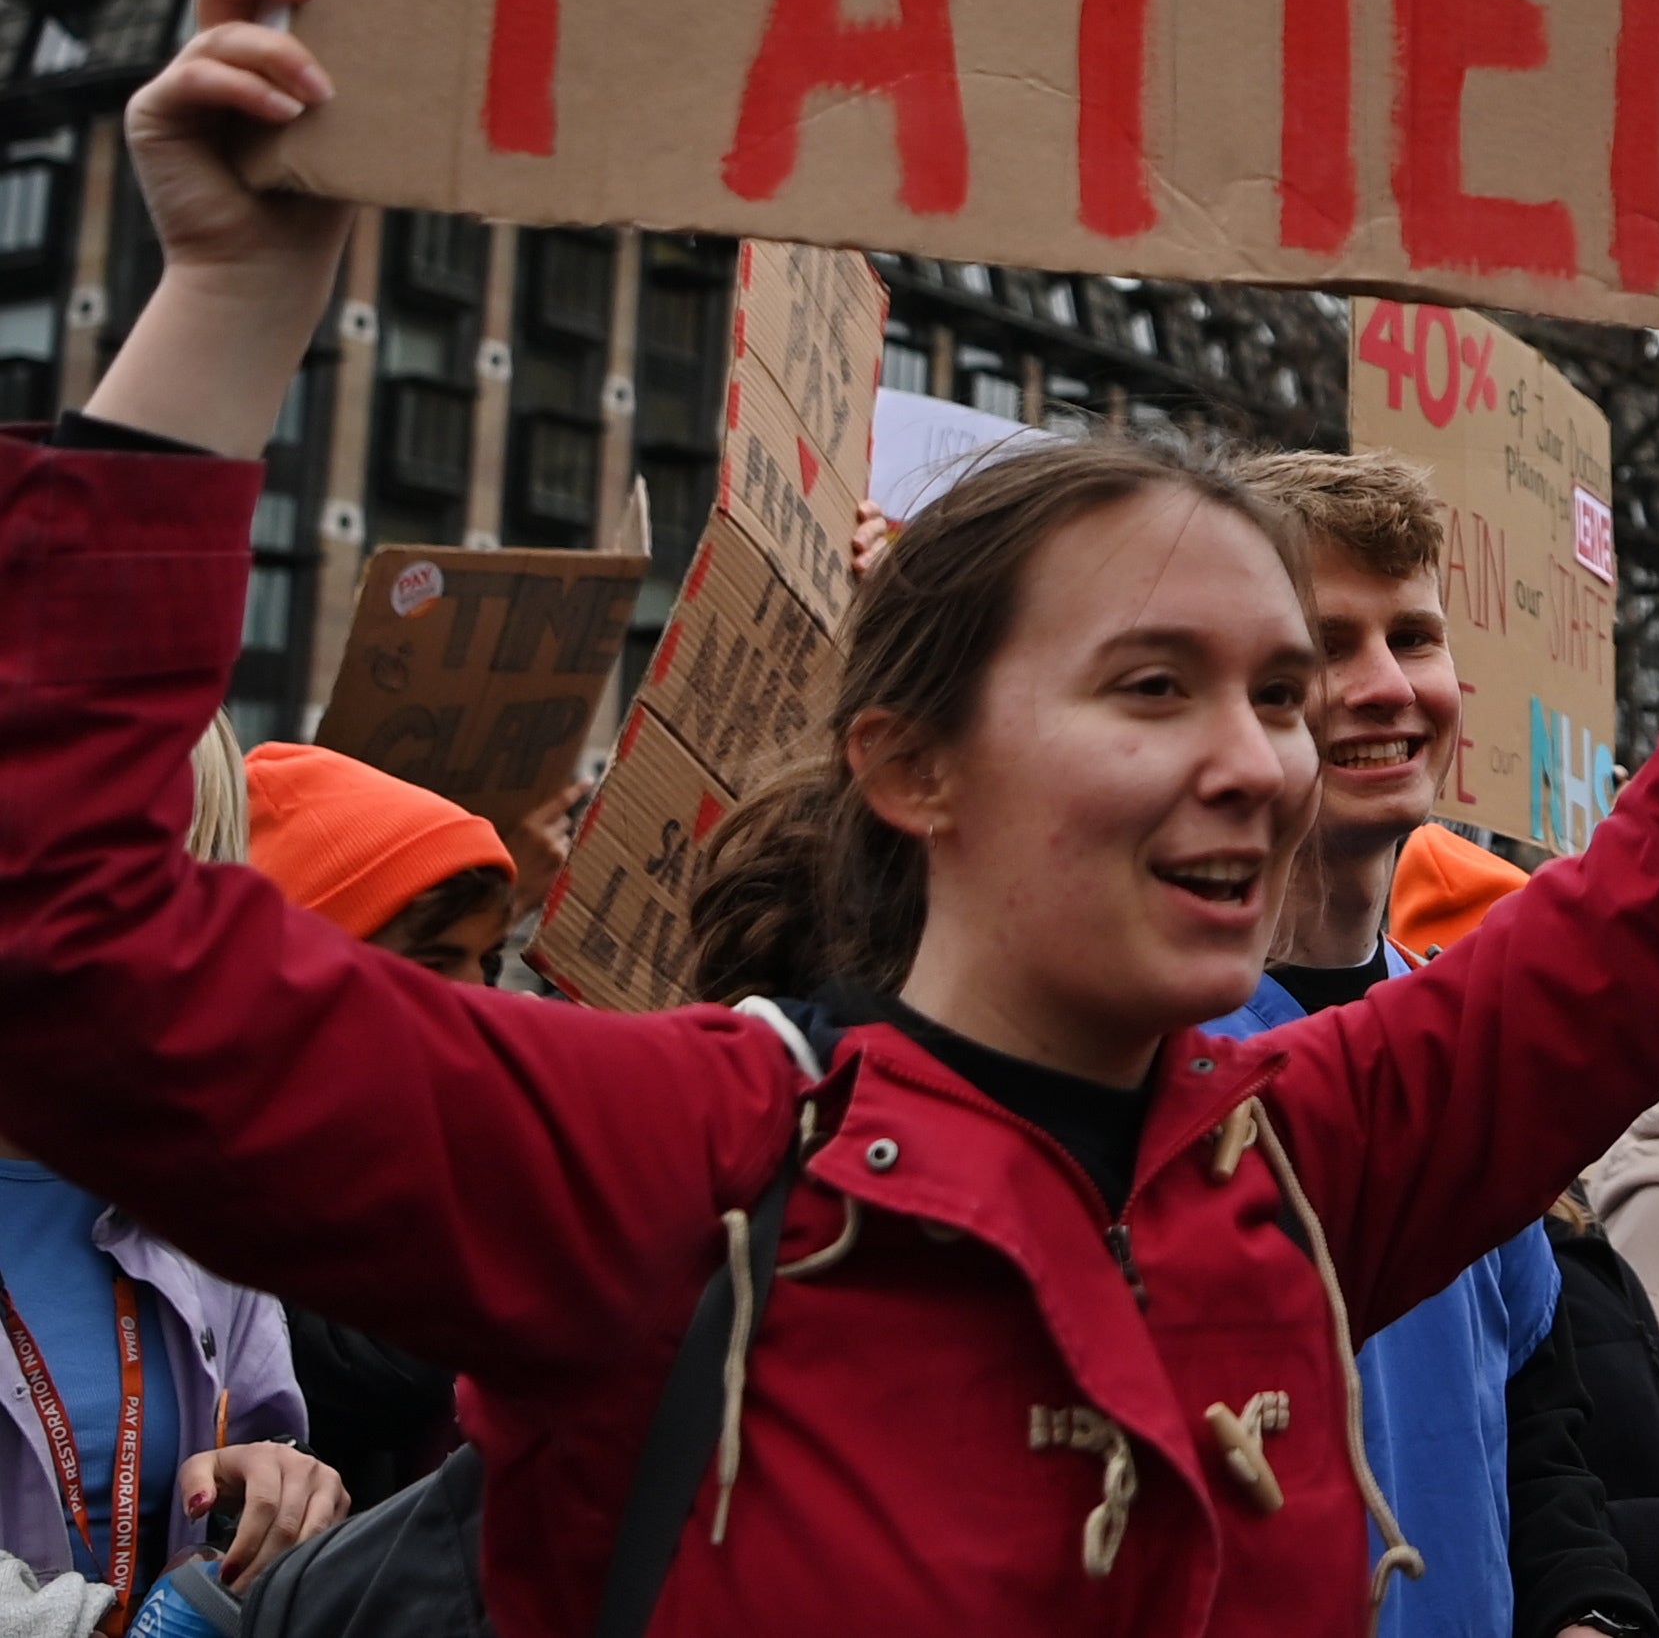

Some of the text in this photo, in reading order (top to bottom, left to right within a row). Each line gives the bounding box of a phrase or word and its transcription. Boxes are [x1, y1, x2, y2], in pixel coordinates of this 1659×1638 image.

[1359, 299, 1497, 429] 40%
[745, 434, 857, 617] PROTEC
[1443, 508, 1506, 635] AIN
[1514, 579, 1544, 619] our
[13, 1330, 81, 1514] PAY RESTORATION NOW
[122, 1331, 138, 1363] BMA
[113, 1395, 140, 1591] PAY RESTORATION NOW
